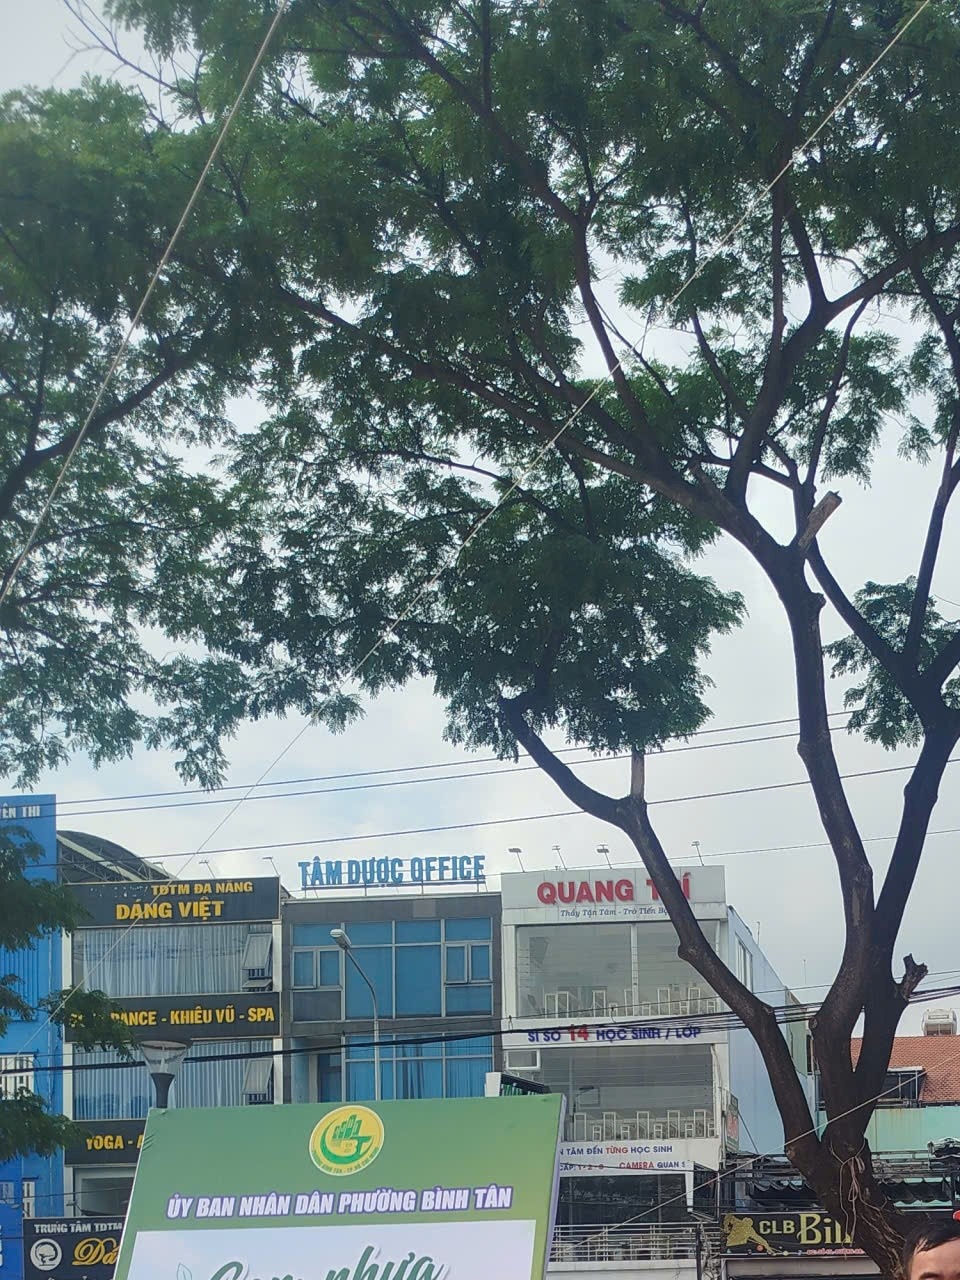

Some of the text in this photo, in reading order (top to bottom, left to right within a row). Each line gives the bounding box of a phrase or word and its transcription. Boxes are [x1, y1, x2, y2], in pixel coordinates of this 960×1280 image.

[298, 856, 342, 888] TÂM
[410, 855, 486, 883] OFFICE
[537, 872, 692, 905] QUANG TÍ
[178, 896, 225, 921] VIỆT
[170, 1006, 212, 1026] KHIÊU
[216, 1004, 235, 1025] VŨ
[248, 1007, 275, 1023] SPA
[568, 1023, 589, 1042] 14
[631, 1027, 661, 1041] SINH
[86, 1134, 124, 1151] YOGA
[653, 1145, 673, 1153] SINH
[619, 1160, 655, 1170] CAMERA
[657, 1160, 680, 1169] QUAN
[166, 1185, 512, 1219] ỦY BAN NHÂN DÂN PHƯỜNG BÌNH TÂN
[34, 1222, 68, 1234] TRUNG
[70, 1220, 91, 1233] TÂM
[759, 1219, 795, 1235] CLB
[72, 1237, 120, 1266] Dá
